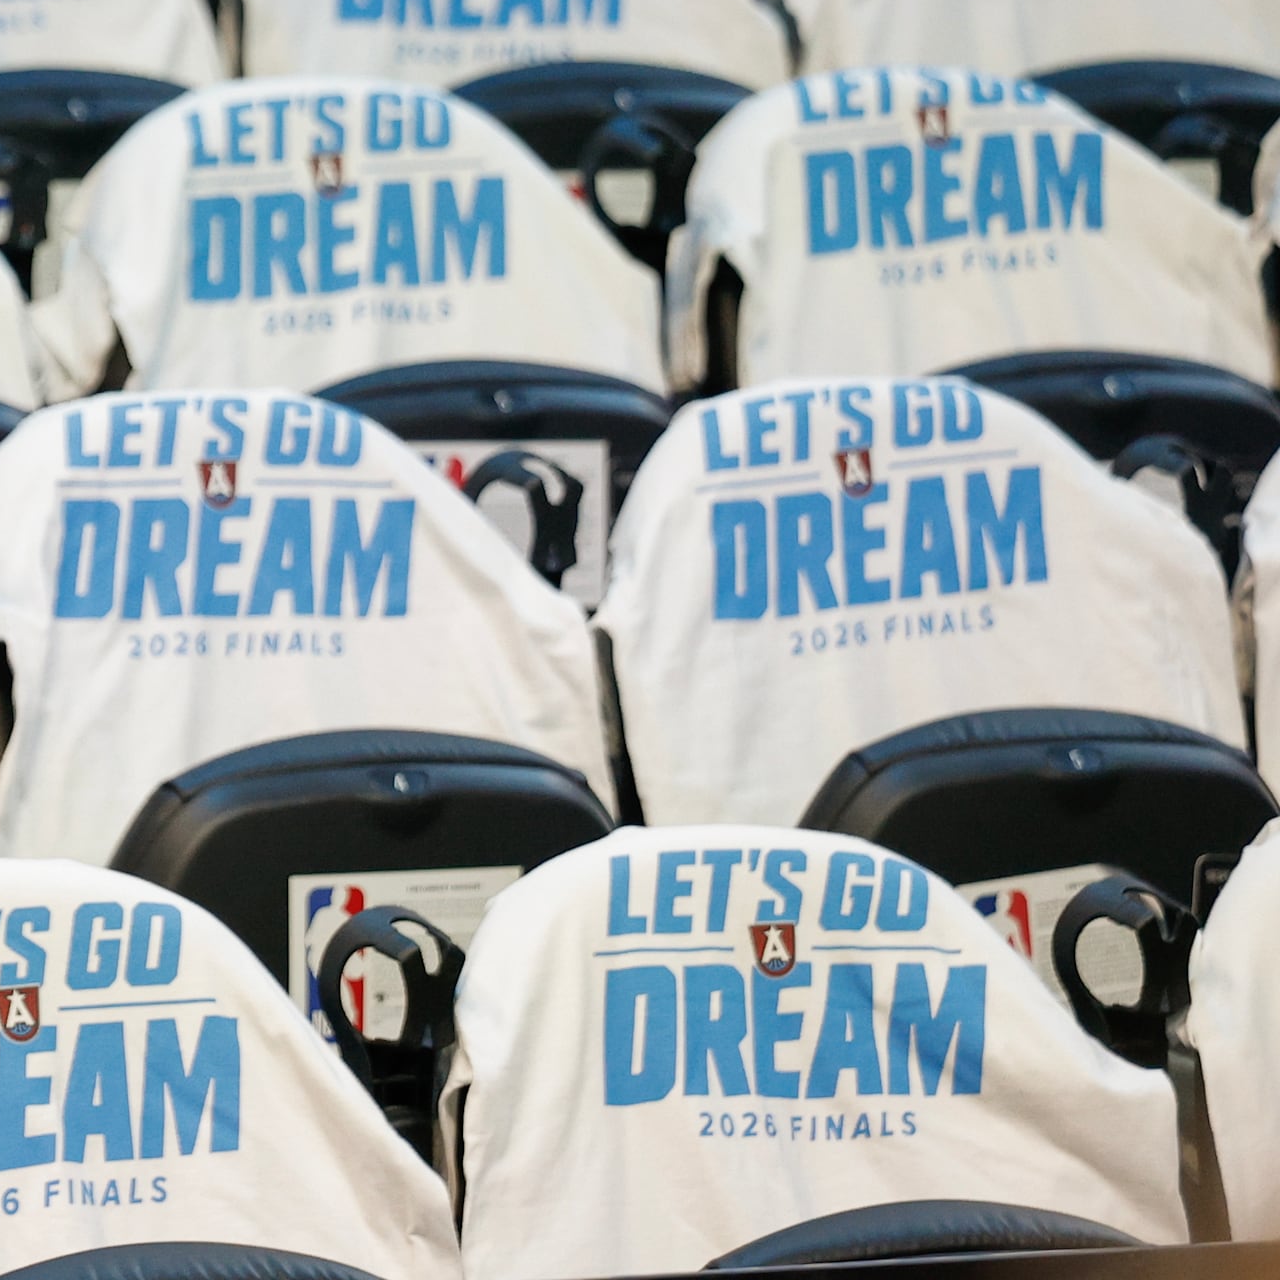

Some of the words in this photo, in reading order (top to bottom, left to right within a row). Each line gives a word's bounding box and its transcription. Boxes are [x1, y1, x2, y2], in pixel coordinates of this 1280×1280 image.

[190, 95, 345, 167] LET'S
[368, 95, 452, 153] GO
[806, 132, 1103, 255] DREAM
[189, 178, 506, 301] DREAM
[68, 399, 247, 467] LET'S
[265, 398, 362, 467] GO
[703, 387, 874, 471] LET'S
[893, 384, 983, 448] GO
[54, 497, 416, 619] DREAM
[712, 467, 1048, 620] DREAM
[128, 631, 209, 658] 2026
[225, 631, 346, 657] FINALS
[609, 850, 807, 936] LET'S
[821, 852, 929, 931] GO
[67, 903, 182, 990] GO
[605, 963, 986, 1106] DREAM
[699, 1112, 777, 1137] 2026
[790, 1111, 917, 1141] FINALS
[44, 1176, 168, 1208] FINALS
